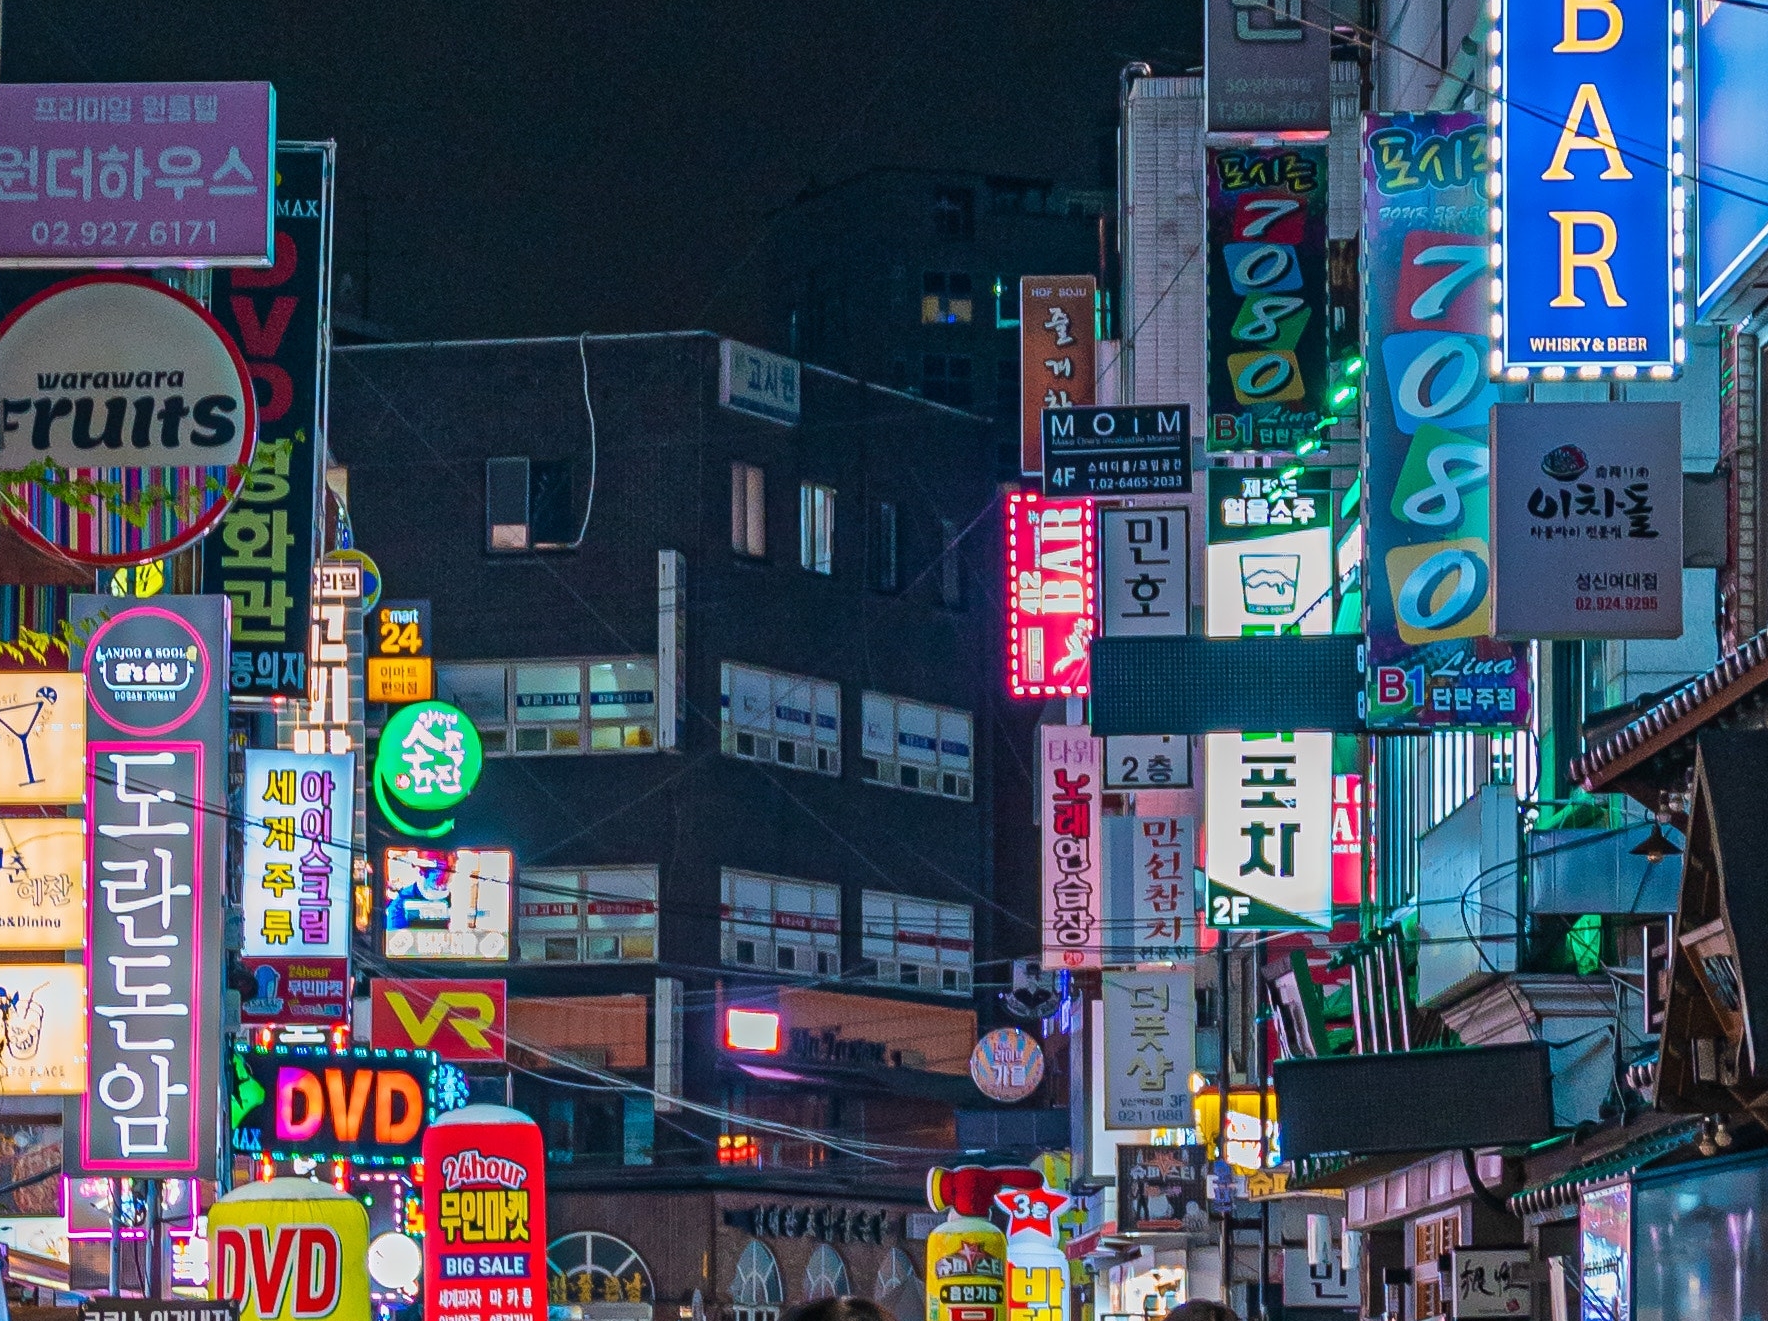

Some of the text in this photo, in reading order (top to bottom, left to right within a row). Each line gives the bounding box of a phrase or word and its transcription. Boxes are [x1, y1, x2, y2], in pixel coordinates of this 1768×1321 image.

[35, 95, 218, 125] 프리미엄 원룸텔
[1217, 152, 1318, 196] 포시즌
[32, 219, 217, 248] 02.927.6171
[36, 369, 185, 394] warawara
[1214, 412, 1255, 445] B1
[1052, 467, 1076, 487] 4F
[1224, 498, 1317, 526] 얼음소주
[1041, 506, 1083, 614] BAR
[1575, 571, 1658, 591] 성신여대점
[380, 608, 419, 624] emart
[380, 623, 422, 654] 24
[380, 666, 418, 679] 이마트
[380, 680, 418, 695] 편의점
[1377, 665, 1425, 707] B1
[1432, 687, 1517, 712] 단란주점
[261, 769, 295, 945] 세계주류
[299, 769, 334, 944] 아이스크림
[1052, 769, 1096, 947] 노래연습장
[1143, 819, 1184, 942] 만선참치
[1212, 897, 1250, 925] 2F
[94, 751, 191, 1158] 도란돈암
[287, 980, 343, 998] 무인마켓
[384, 990, 496, 1050] VR
[277, 1066, 424, 1145] DVD
[442, 1150, 527, 1192] 24hour
[440, 1189, 530, 1245] 무인마켓
[217, 1223, 341, 1321] DVD
[445, 1255, 525, 1276] BIG SALE
[439, 1288, 482, 1309] 세계과자
